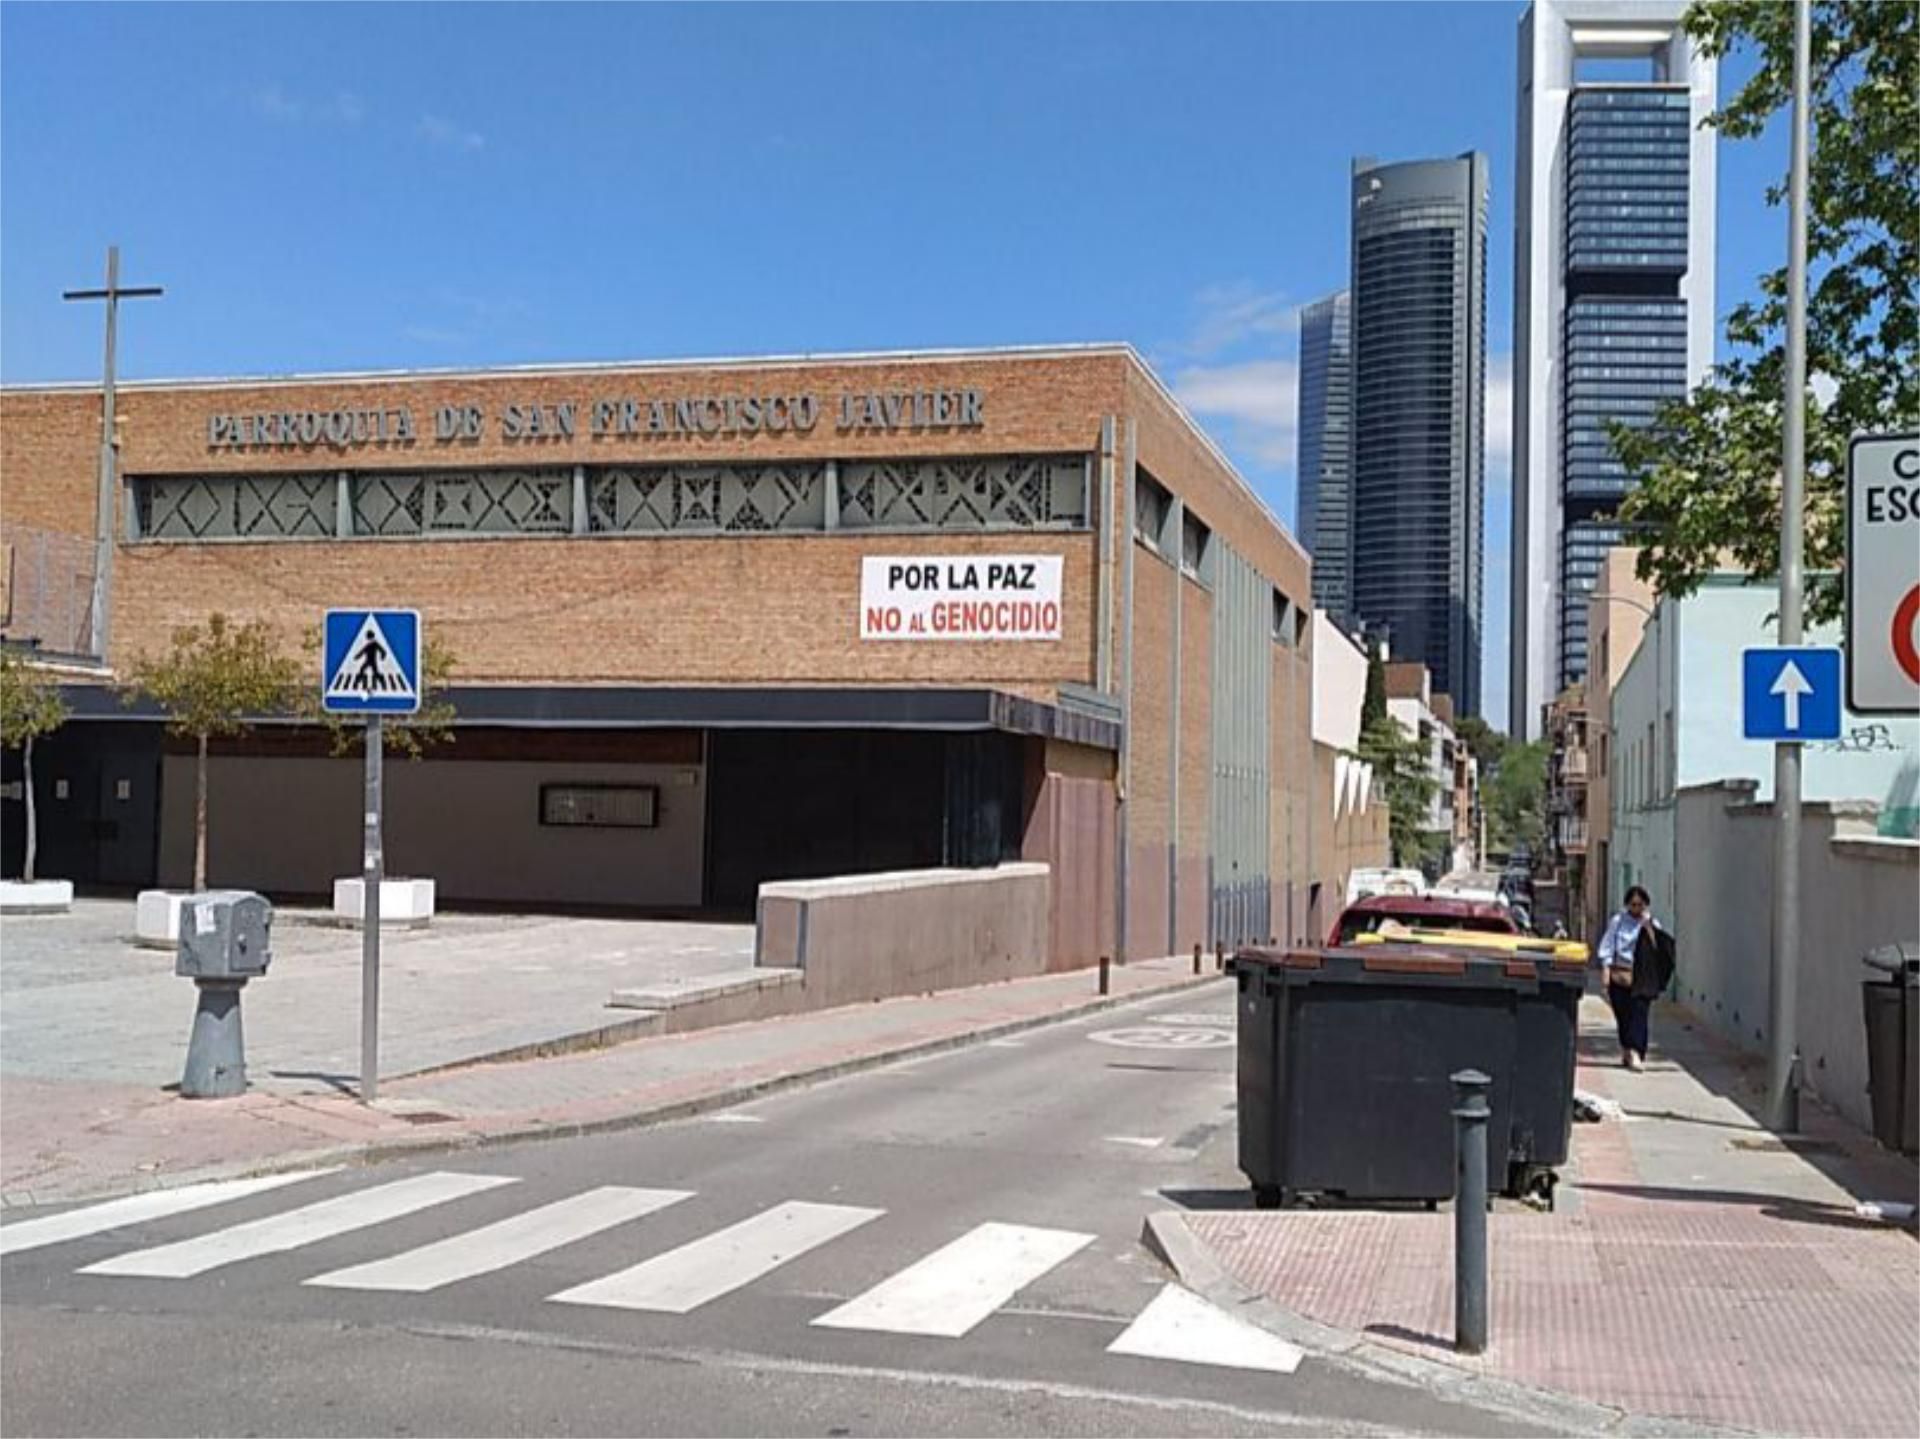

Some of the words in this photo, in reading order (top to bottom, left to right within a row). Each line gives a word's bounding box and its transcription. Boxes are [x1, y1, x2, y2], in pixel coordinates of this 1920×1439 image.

[208, 405, 416, 447] PARROQUIA
[436, 403, 485, 441] DE
[502, 403, 577, 439] SAN
[591, 392, 819, 434] FRANCISCO
[835, 385, 984, 429] JAVIER
[888, 565, 940, 591] POR
[948, 565, 979, 590] LA
[988, 564, 1036, 590] PAZ
[867, 607, 902, 632] NO
[909, 613, 927, 632] AL
[931, 601, 1058, 632] GENOCIDIO
